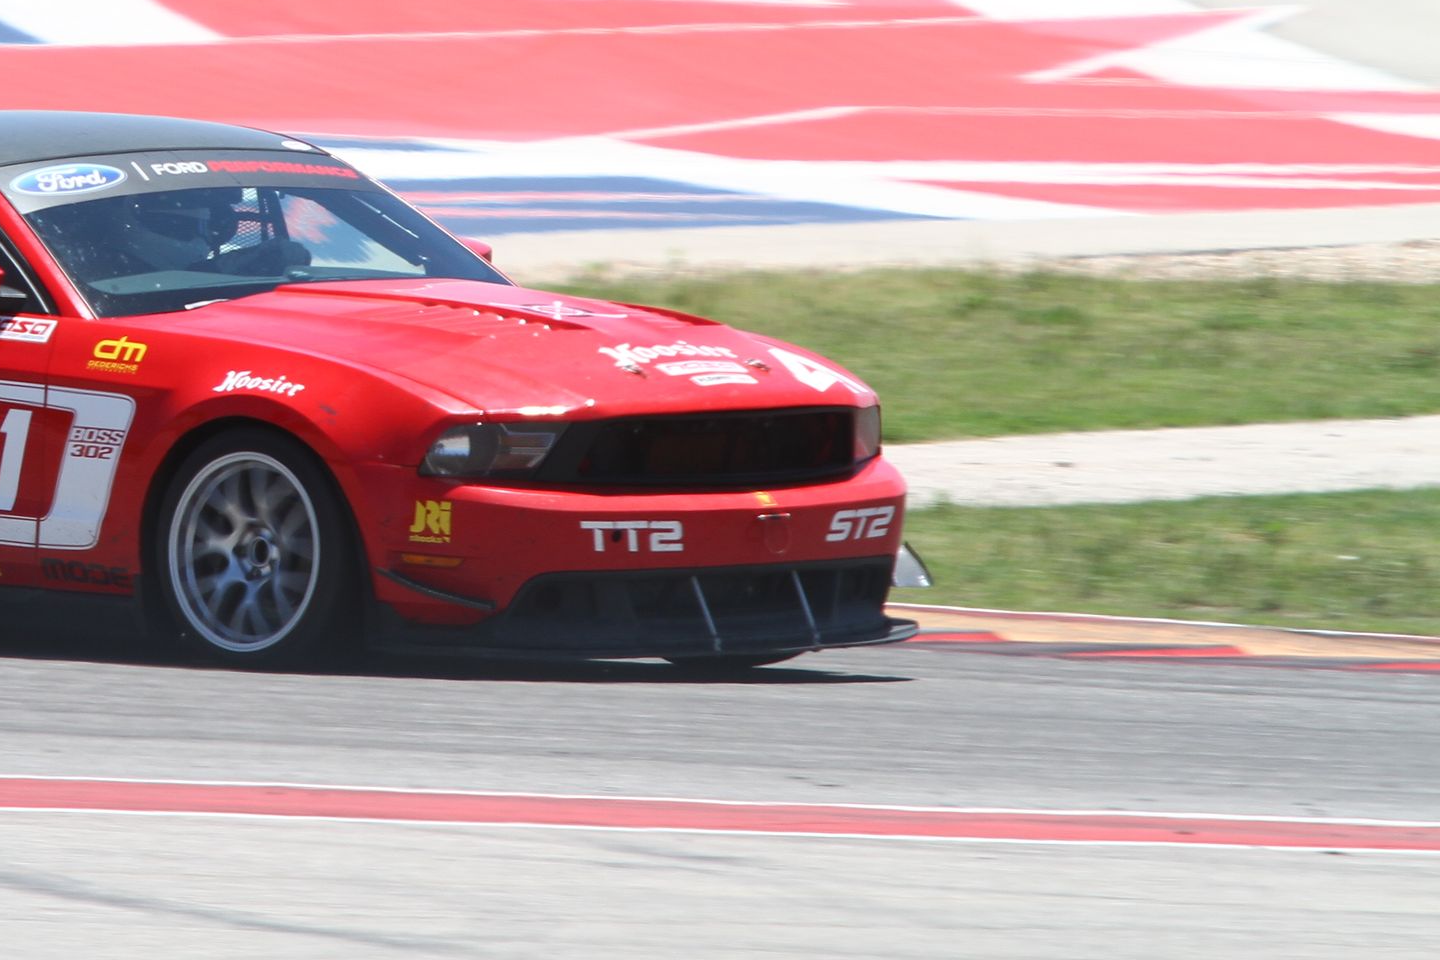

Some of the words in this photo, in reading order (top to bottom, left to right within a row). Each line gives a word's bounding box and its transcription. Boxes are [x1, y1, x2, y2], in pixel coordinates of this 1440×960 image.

[151, 161, 208, 176] FORD
[207, 160, 359, 179] PERFORMANCE
[598, 340, 738, 368] Hoosier
[212, 370, 305, 397] Hoosier
[69, 427, 125, 445] BOSS
[70, 444, 113, 459] 302
[580, 521, 683, 552] TT2
[825, 506, 895, 542] ST2
